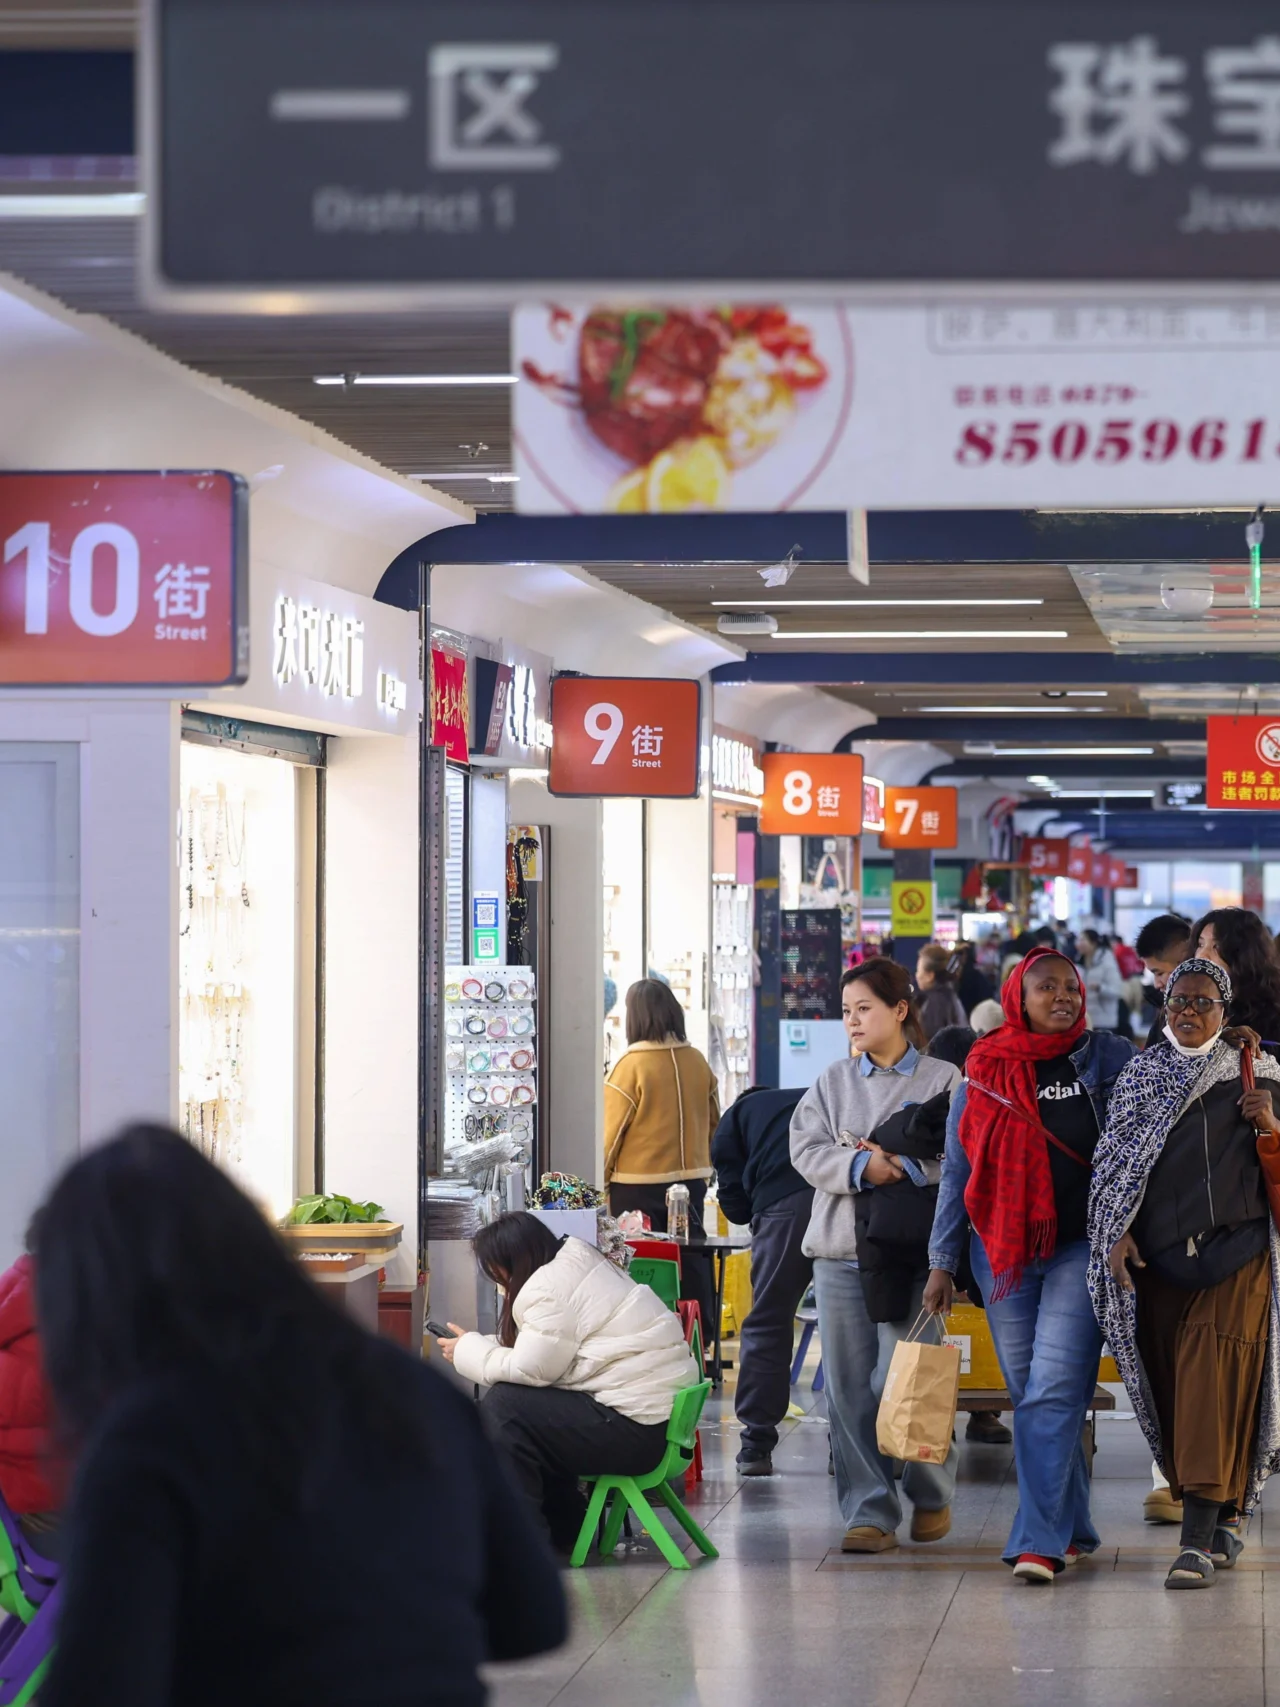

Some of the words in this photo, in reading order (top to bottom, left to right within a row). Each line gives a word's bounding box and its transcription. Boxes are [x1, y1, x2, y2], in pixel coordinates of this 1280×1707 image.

[269, 42, 559, 169] 一区
[313, 190, 481, 232] District
[494, 191, 515, 230] 1
[154, 624, 207, 641] Street
[631, 758, 662, 768] Street
